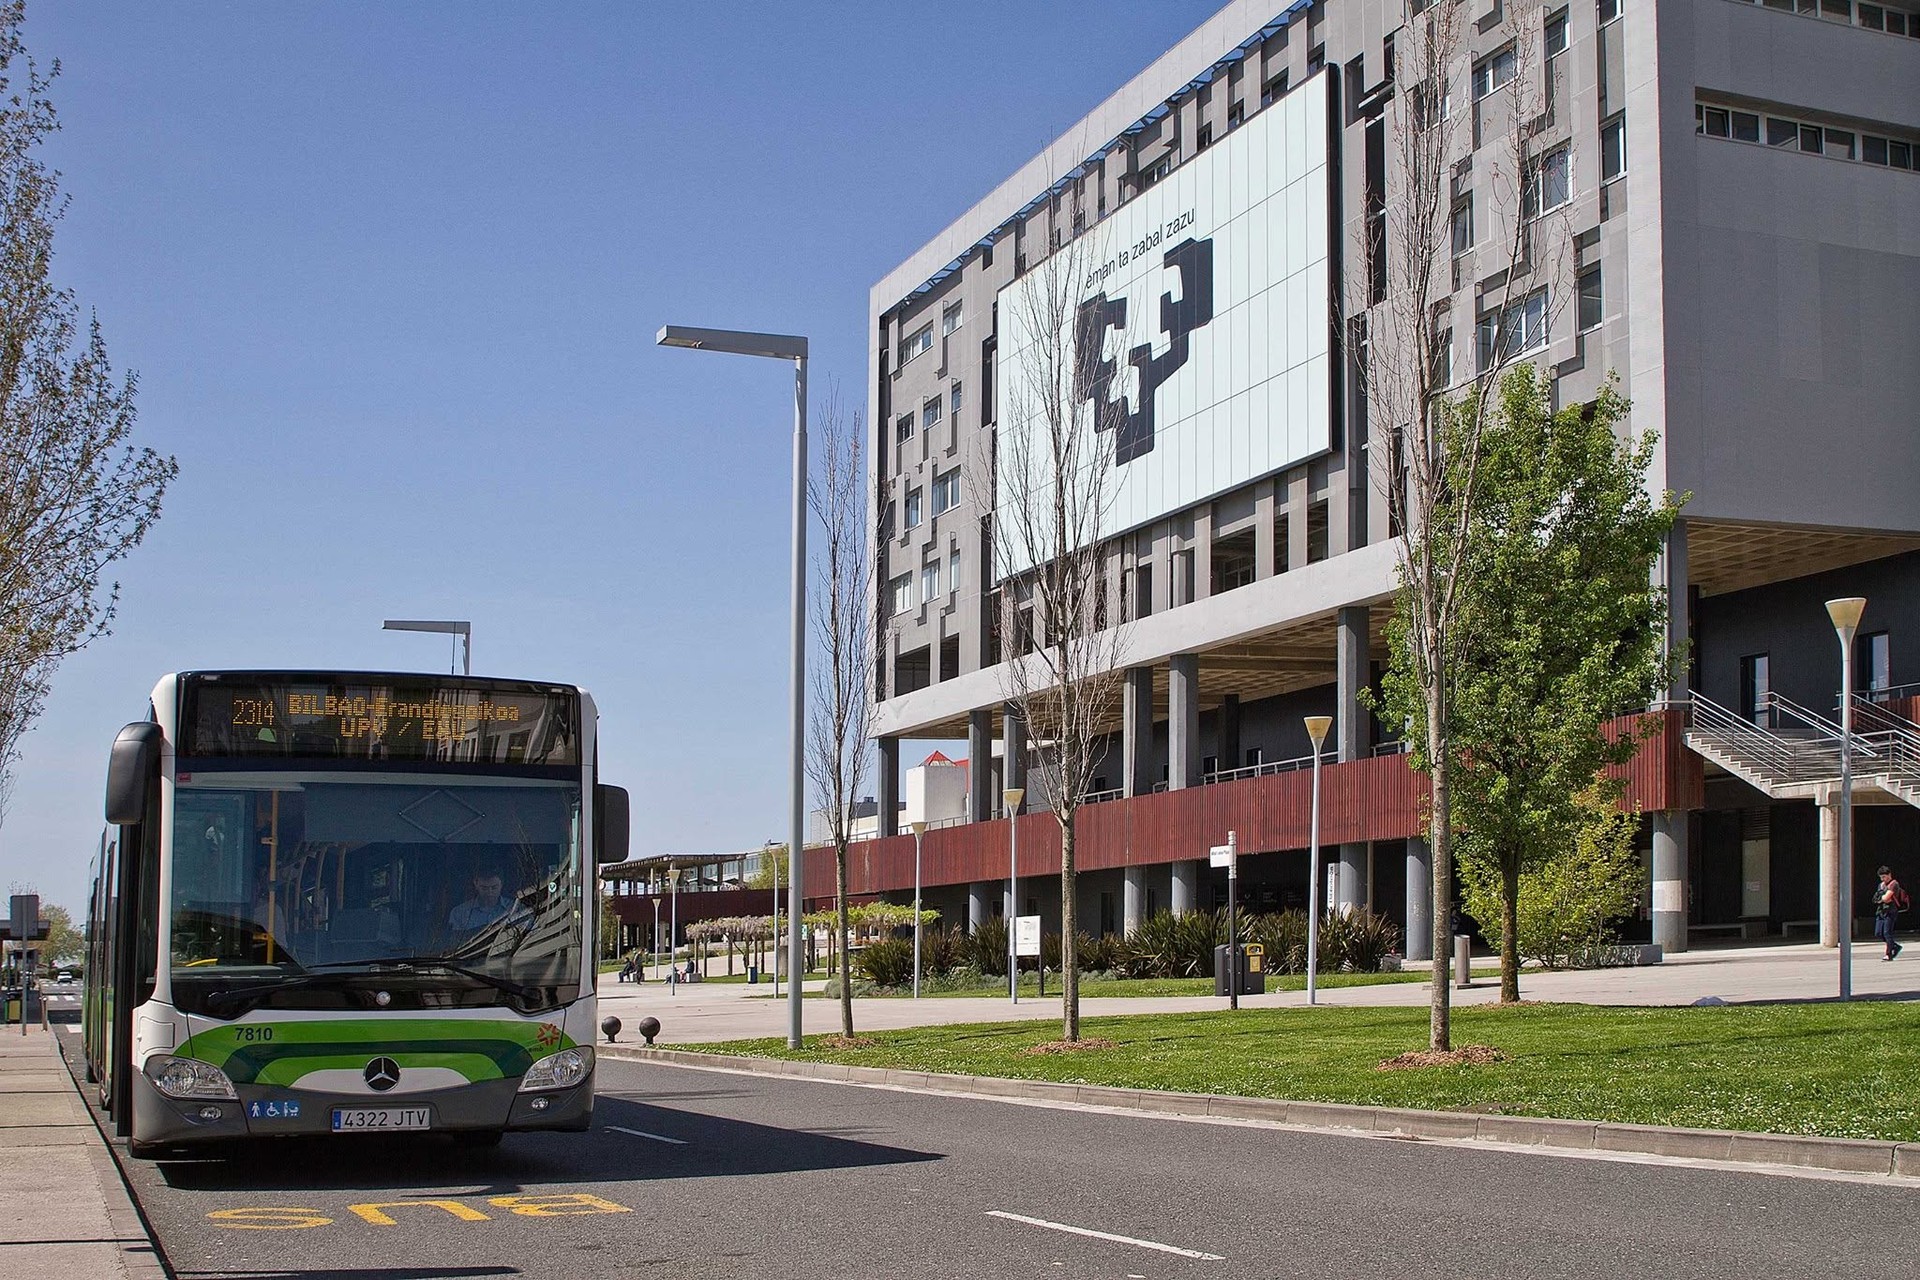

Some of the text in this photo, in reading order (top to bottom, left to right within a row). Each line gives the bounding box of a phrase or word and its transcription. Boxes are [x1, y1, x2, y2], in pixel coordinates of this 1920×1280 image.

[1086, 208, 1195, 289] eman ta zabal zazu
[232, 700, 274, 725] 2314
[341, 717, 466, 740] UPV / EHU
[235, 1027, 273, 1041] 7810
[344, 1110, 426, 1127] 4322 JTV
[206, 1193, 633, 1230] BUS
